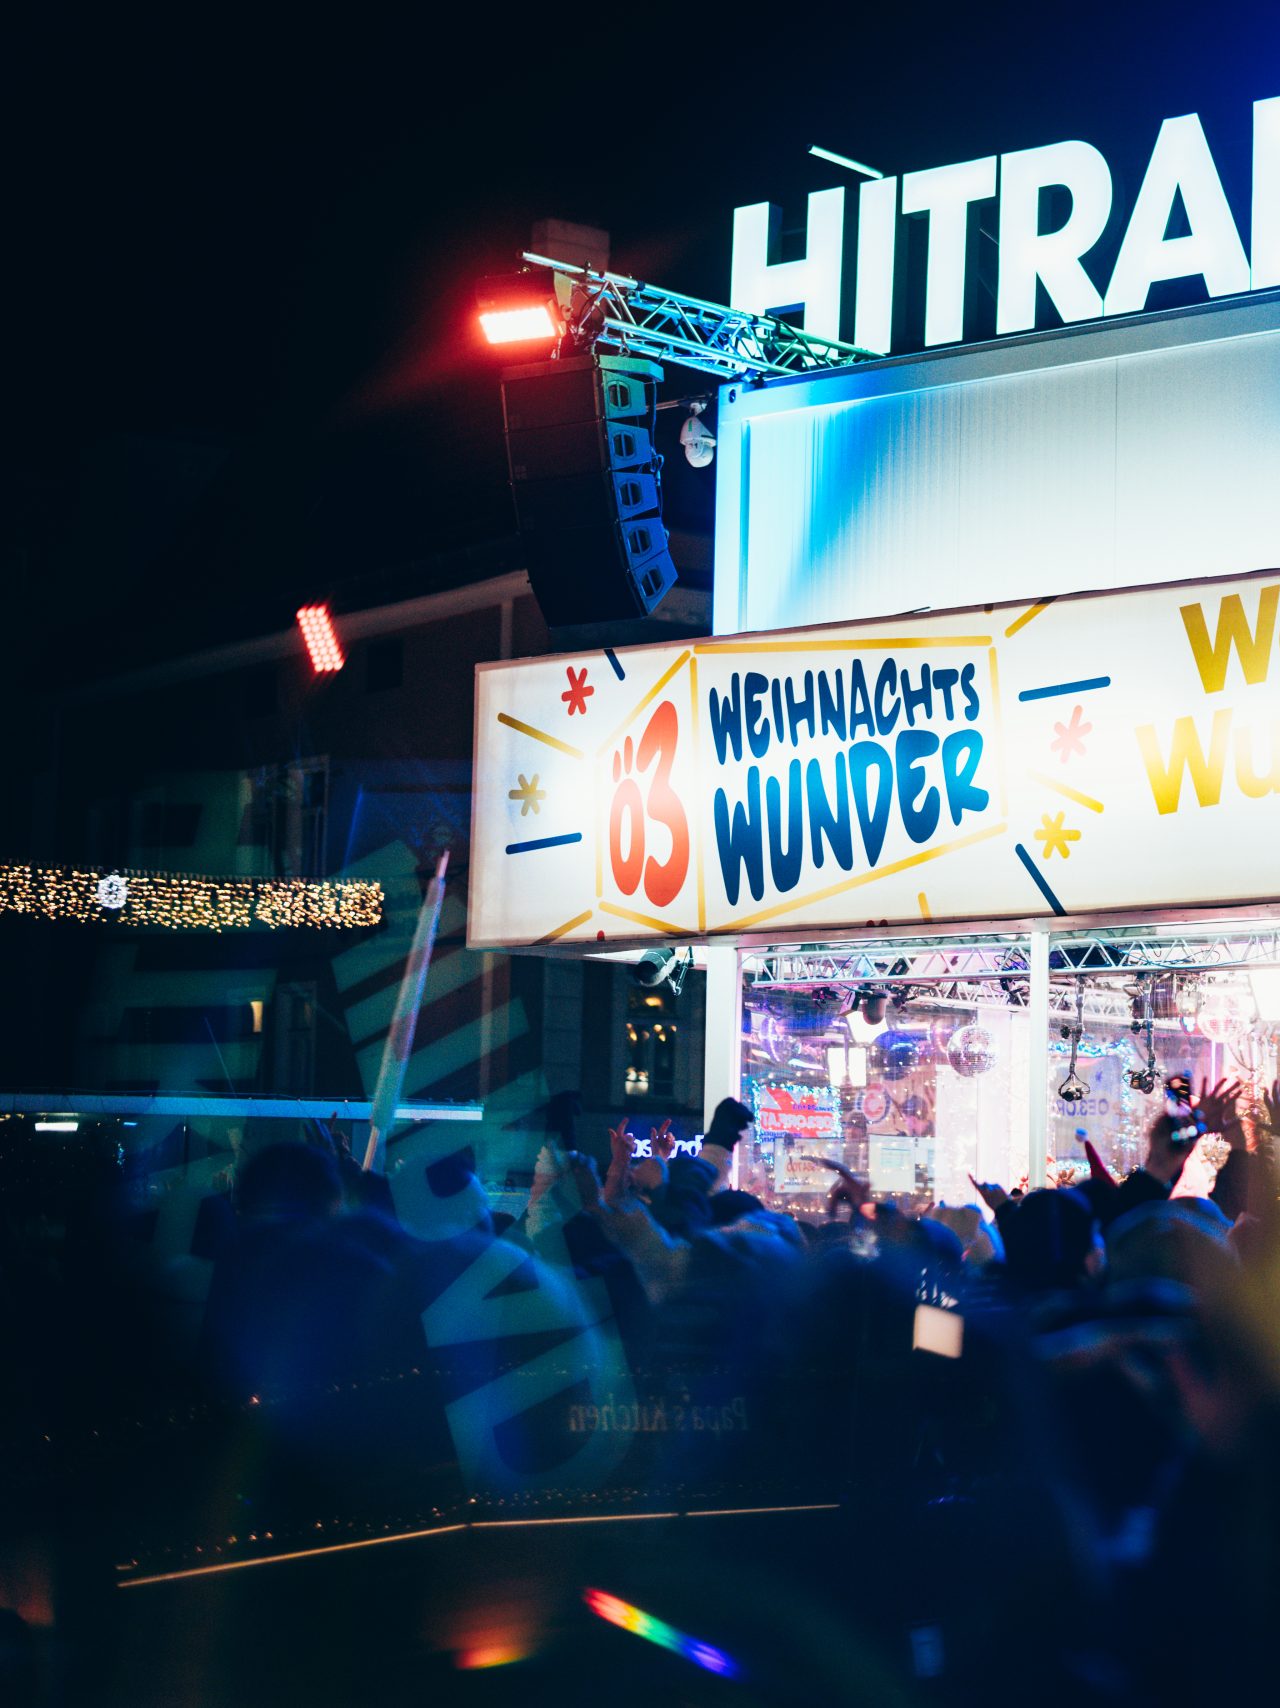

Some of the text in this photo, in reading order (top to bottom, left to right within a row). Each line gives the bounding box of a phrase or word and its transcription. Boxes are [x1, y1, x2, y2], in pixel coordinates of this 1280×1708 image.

[709, 657, 977, 765] WEIHNACHTS
[609, 700, 690, 907] Ö3
[713, 728, 989, 906] WUNDER
